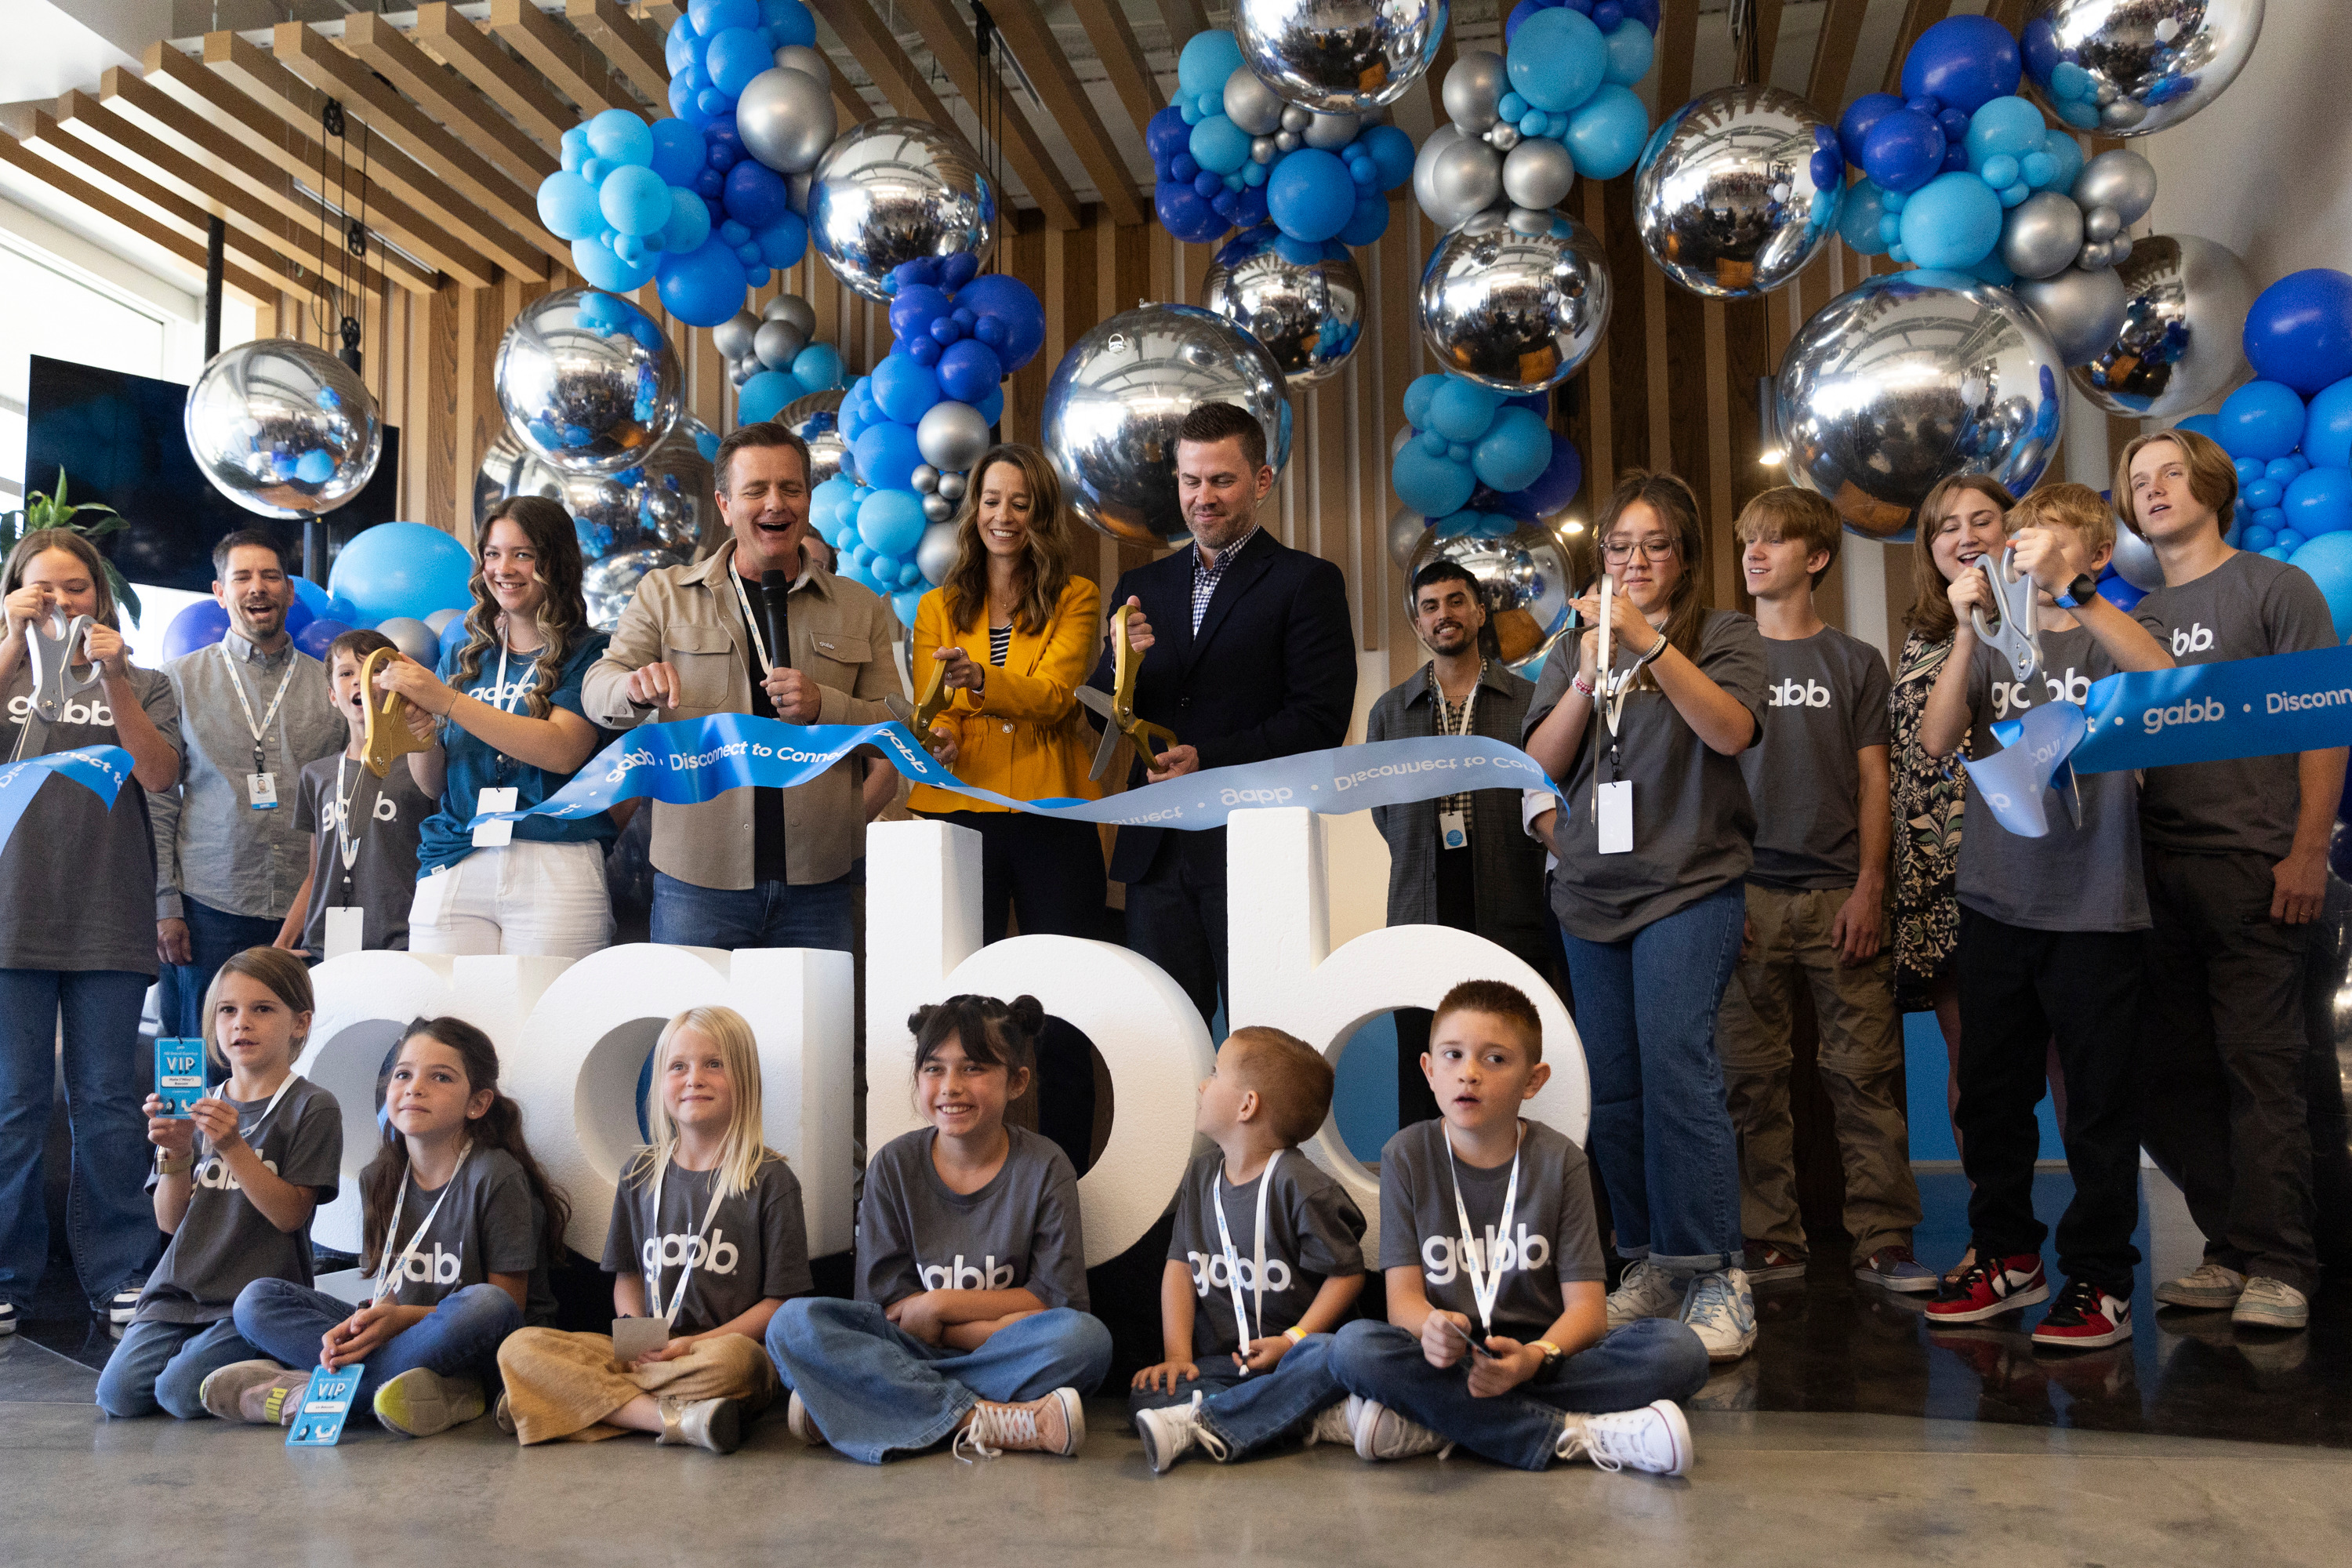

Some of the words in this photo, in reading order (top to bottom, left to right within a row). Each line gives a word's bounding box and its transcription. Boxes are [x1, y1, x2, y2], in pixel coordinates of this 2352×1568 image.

[2169, 622, 2213, 656] bb
[1769, 678, 1830, 707] abb
[7, 695, 115, 727] gbb
[2143, 696, 2225, 734] gabb
[605, 747, 655, 783] gabb
[670, 741, 748, 771] Disconnect
[751, 742, 771, 757] to
[873, 728, 928, 774] gabb
[322, 790, 397, 832] gab
[166, 1057, 195, 1073] VIP
[916, 1254, 1014, 1291] abb
[318, 1382, 345, 1399] VIP
